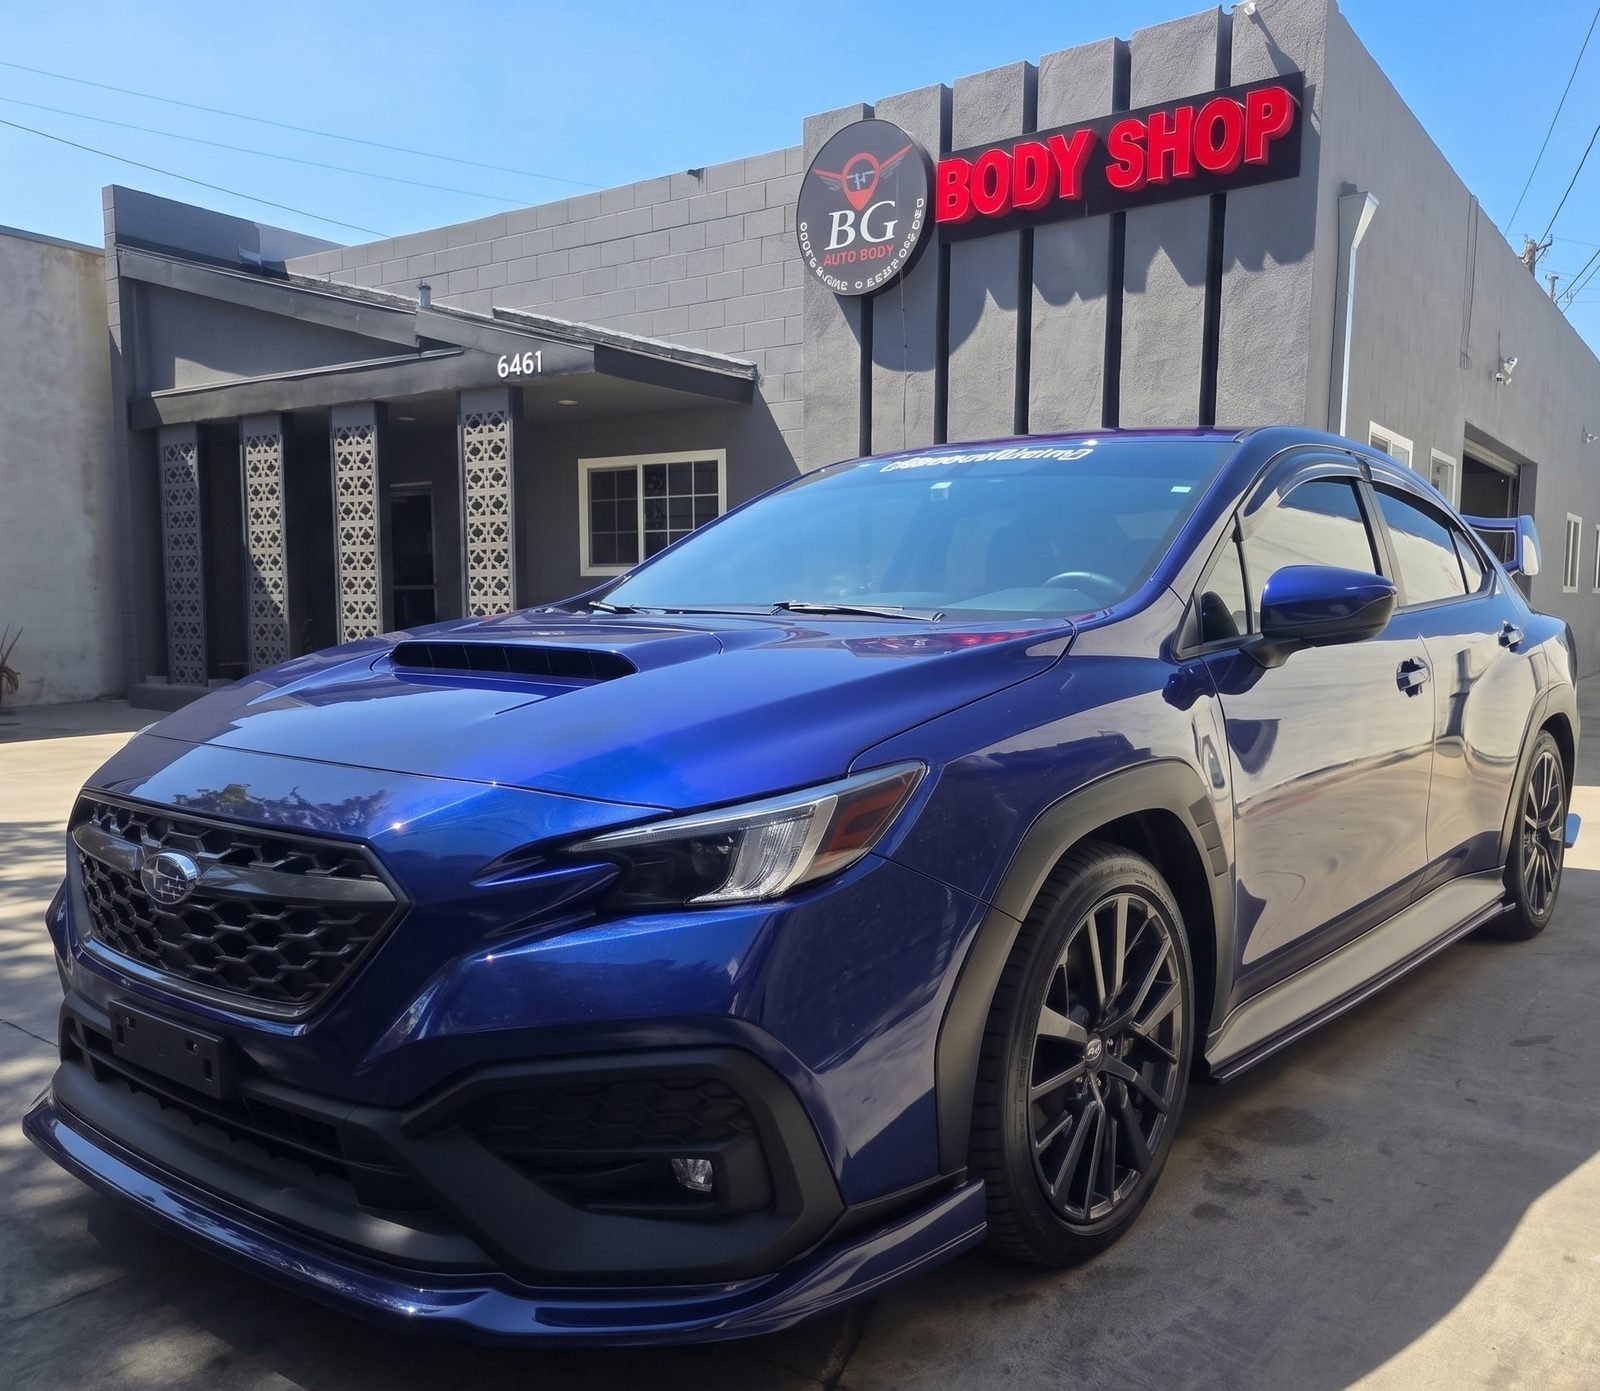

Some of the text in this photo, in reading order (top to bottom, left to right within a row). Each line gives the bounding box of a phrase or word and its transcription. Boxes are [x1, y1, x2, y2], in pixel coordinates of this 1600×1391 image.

[936, 86, 1294, 224] BODY SHOP
[824, 201, 898, 250] BG
[823, 243, 894, 266] AUTO BODY
[497, 350, 542, 378] 6461
